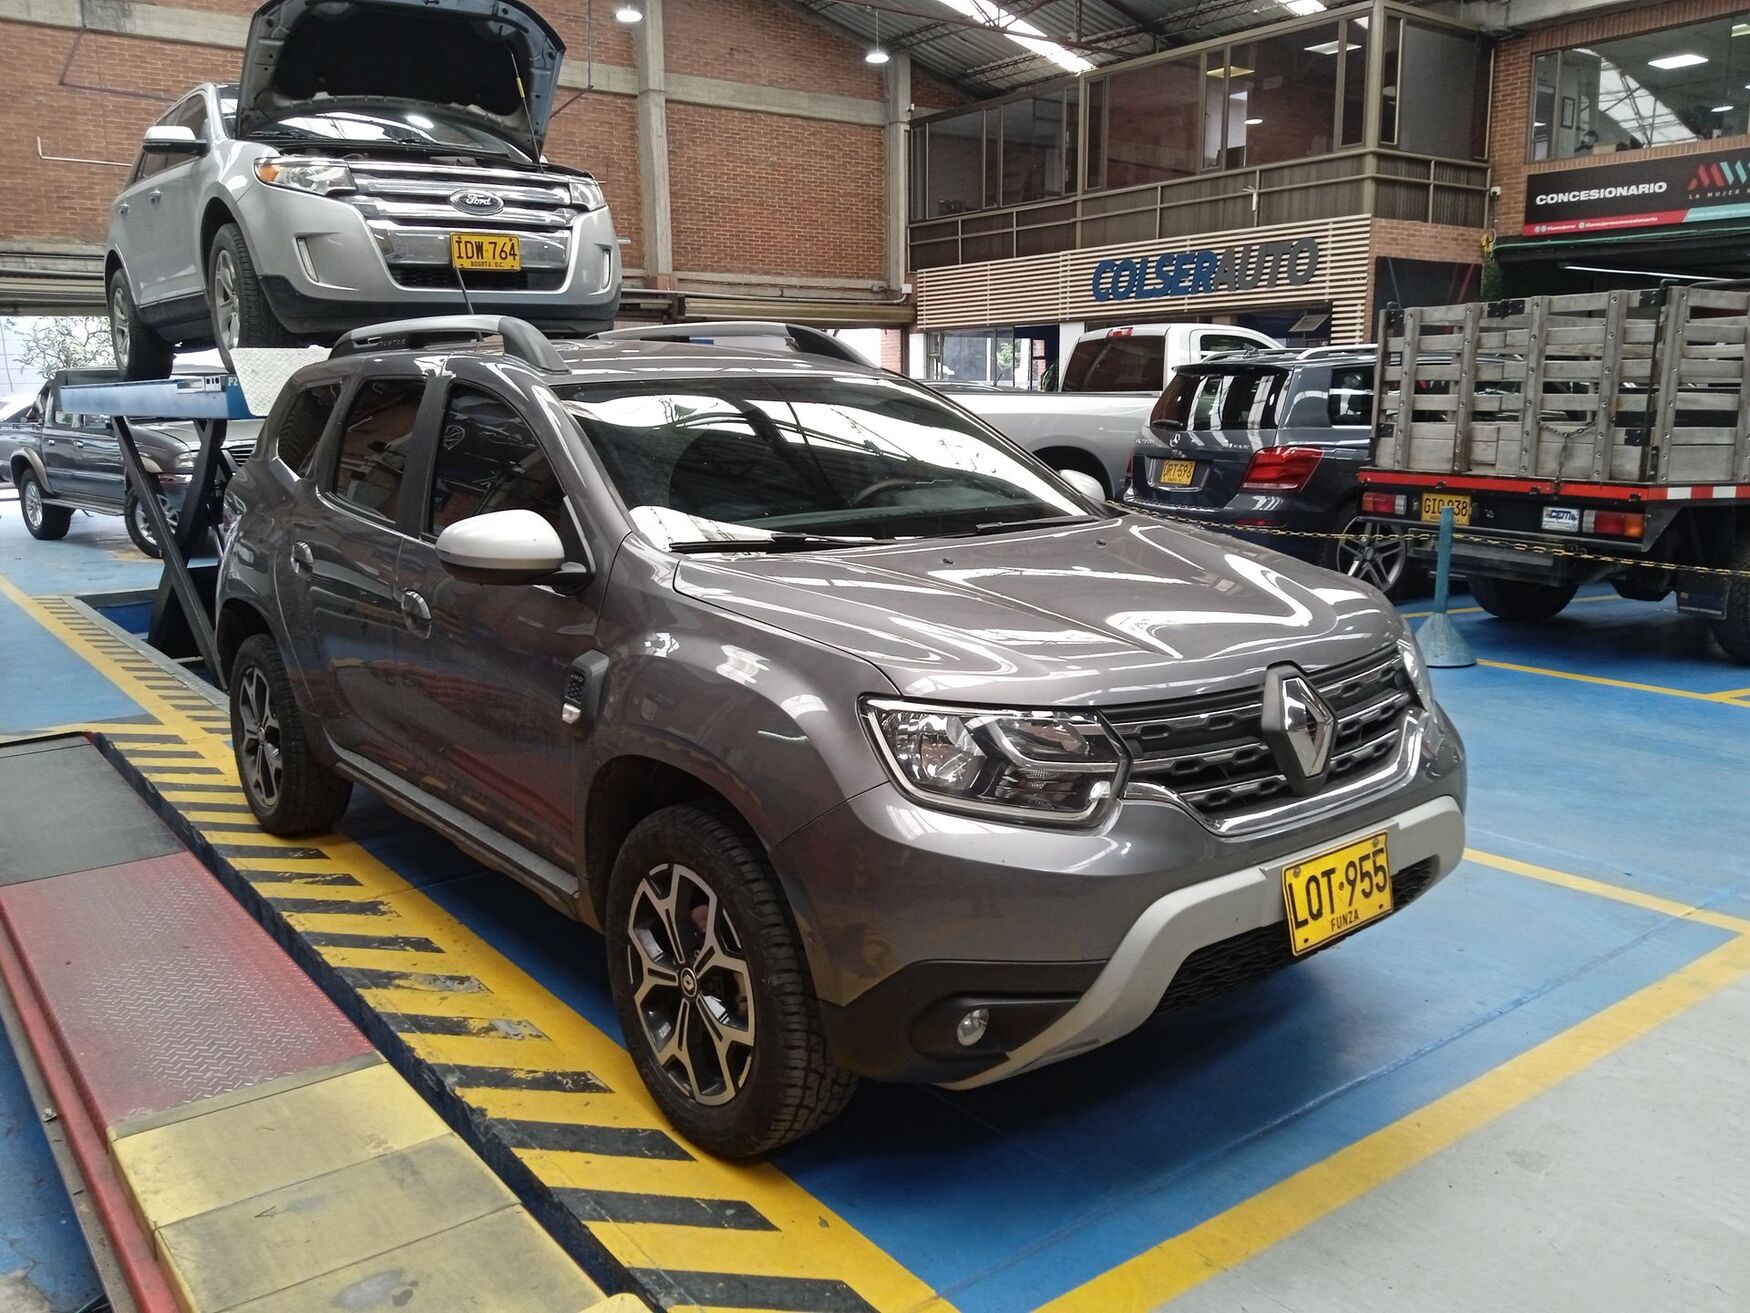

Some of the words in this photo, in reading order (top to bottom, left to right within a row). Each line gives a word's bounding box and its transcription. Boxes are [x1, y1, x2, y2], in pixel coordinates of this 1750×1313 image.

[466, 193, 492, 206] Ford
[1535, 181, 1668, 205] CONCESIONARIO
[1707, 188, 1740, 198] MUJER
[1092, 237, 1319, 302] COLSERAUTO
[1330, 908, 1360, 931] FUNZA
